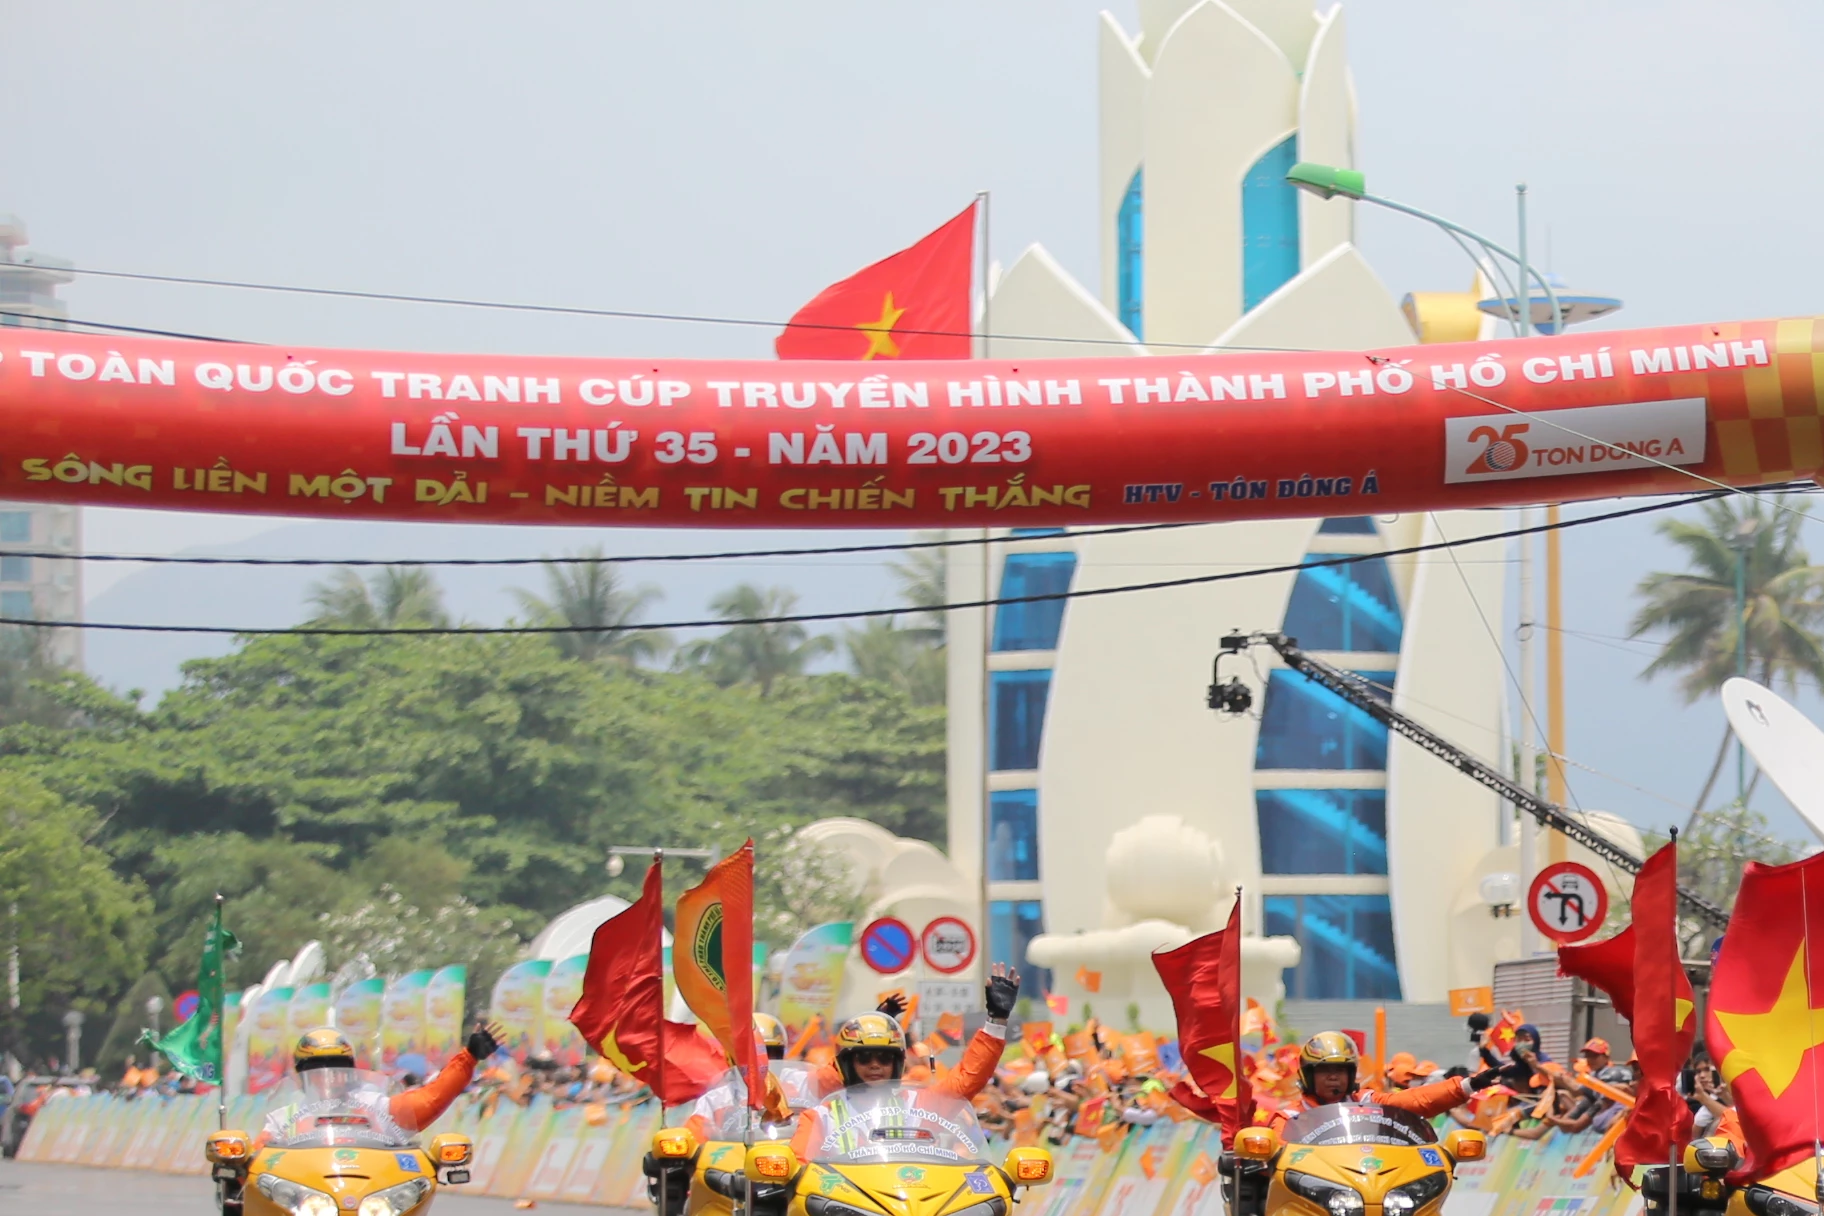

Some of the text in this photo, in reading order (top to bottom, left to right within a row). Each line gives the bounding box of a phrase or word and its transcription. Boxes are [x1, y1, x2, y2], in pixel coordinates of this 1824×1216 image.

[20, 339, 1769, 408] TOÀN QUỐC TRANH CÚP TRUYỀN HÌNH THÀNH PHỐ HỒ CHÍ MINH
[390, 412, 1032, 465] LẦN THỨ 35 NĂM 2023
[1465, 423, 1684, 474] 25 TON DONG A
[21, 453, 1091, 511] SÔNG LIỀN MỘT DẢI NIỀM TIN CHIẾN THẮNG
[1123, 483, 1183, 504] HTV
[1211, 475, 1267, 500] TÔN
[1361, 472, 1380, 495] Á
[934, 1147, 959, 1160] MINH
